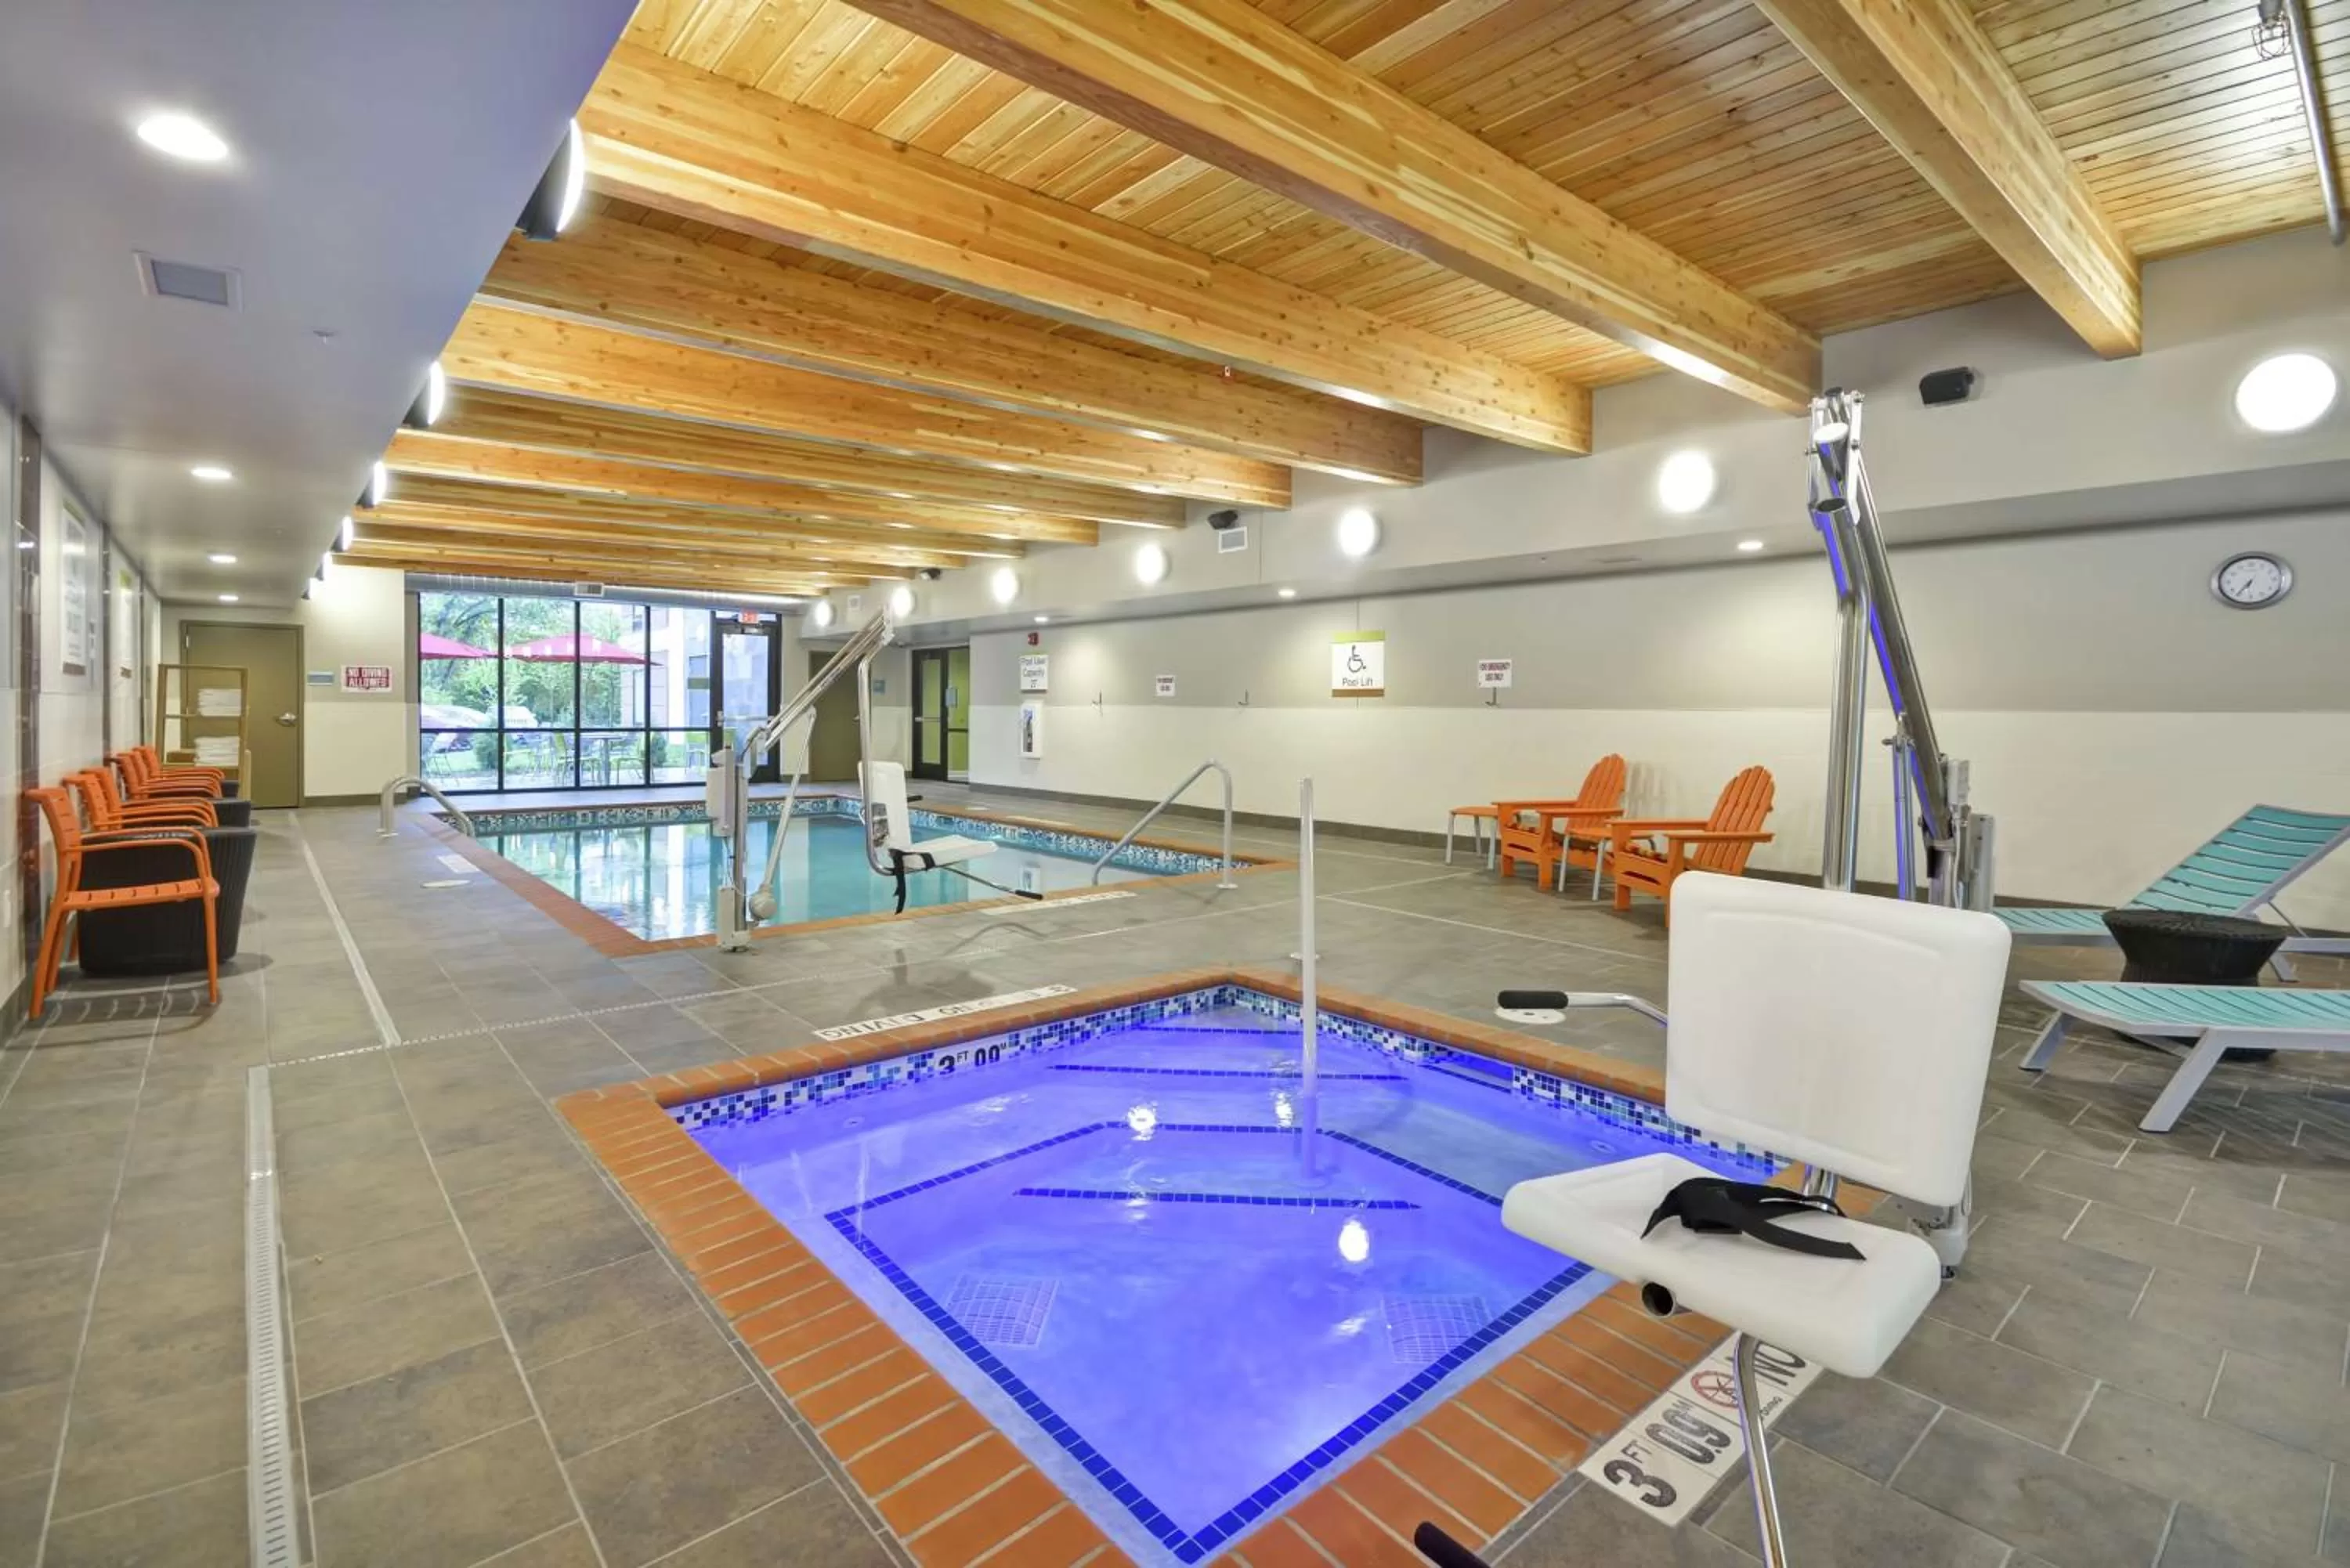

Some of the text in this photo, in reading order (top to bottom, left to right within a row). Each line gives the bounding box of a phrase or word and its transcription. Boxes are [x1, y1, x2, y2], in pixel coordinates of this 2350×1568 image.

[1342, 677, 1373, 687] Pool Lift
[822, 1013, 925, 1039] DIVING
